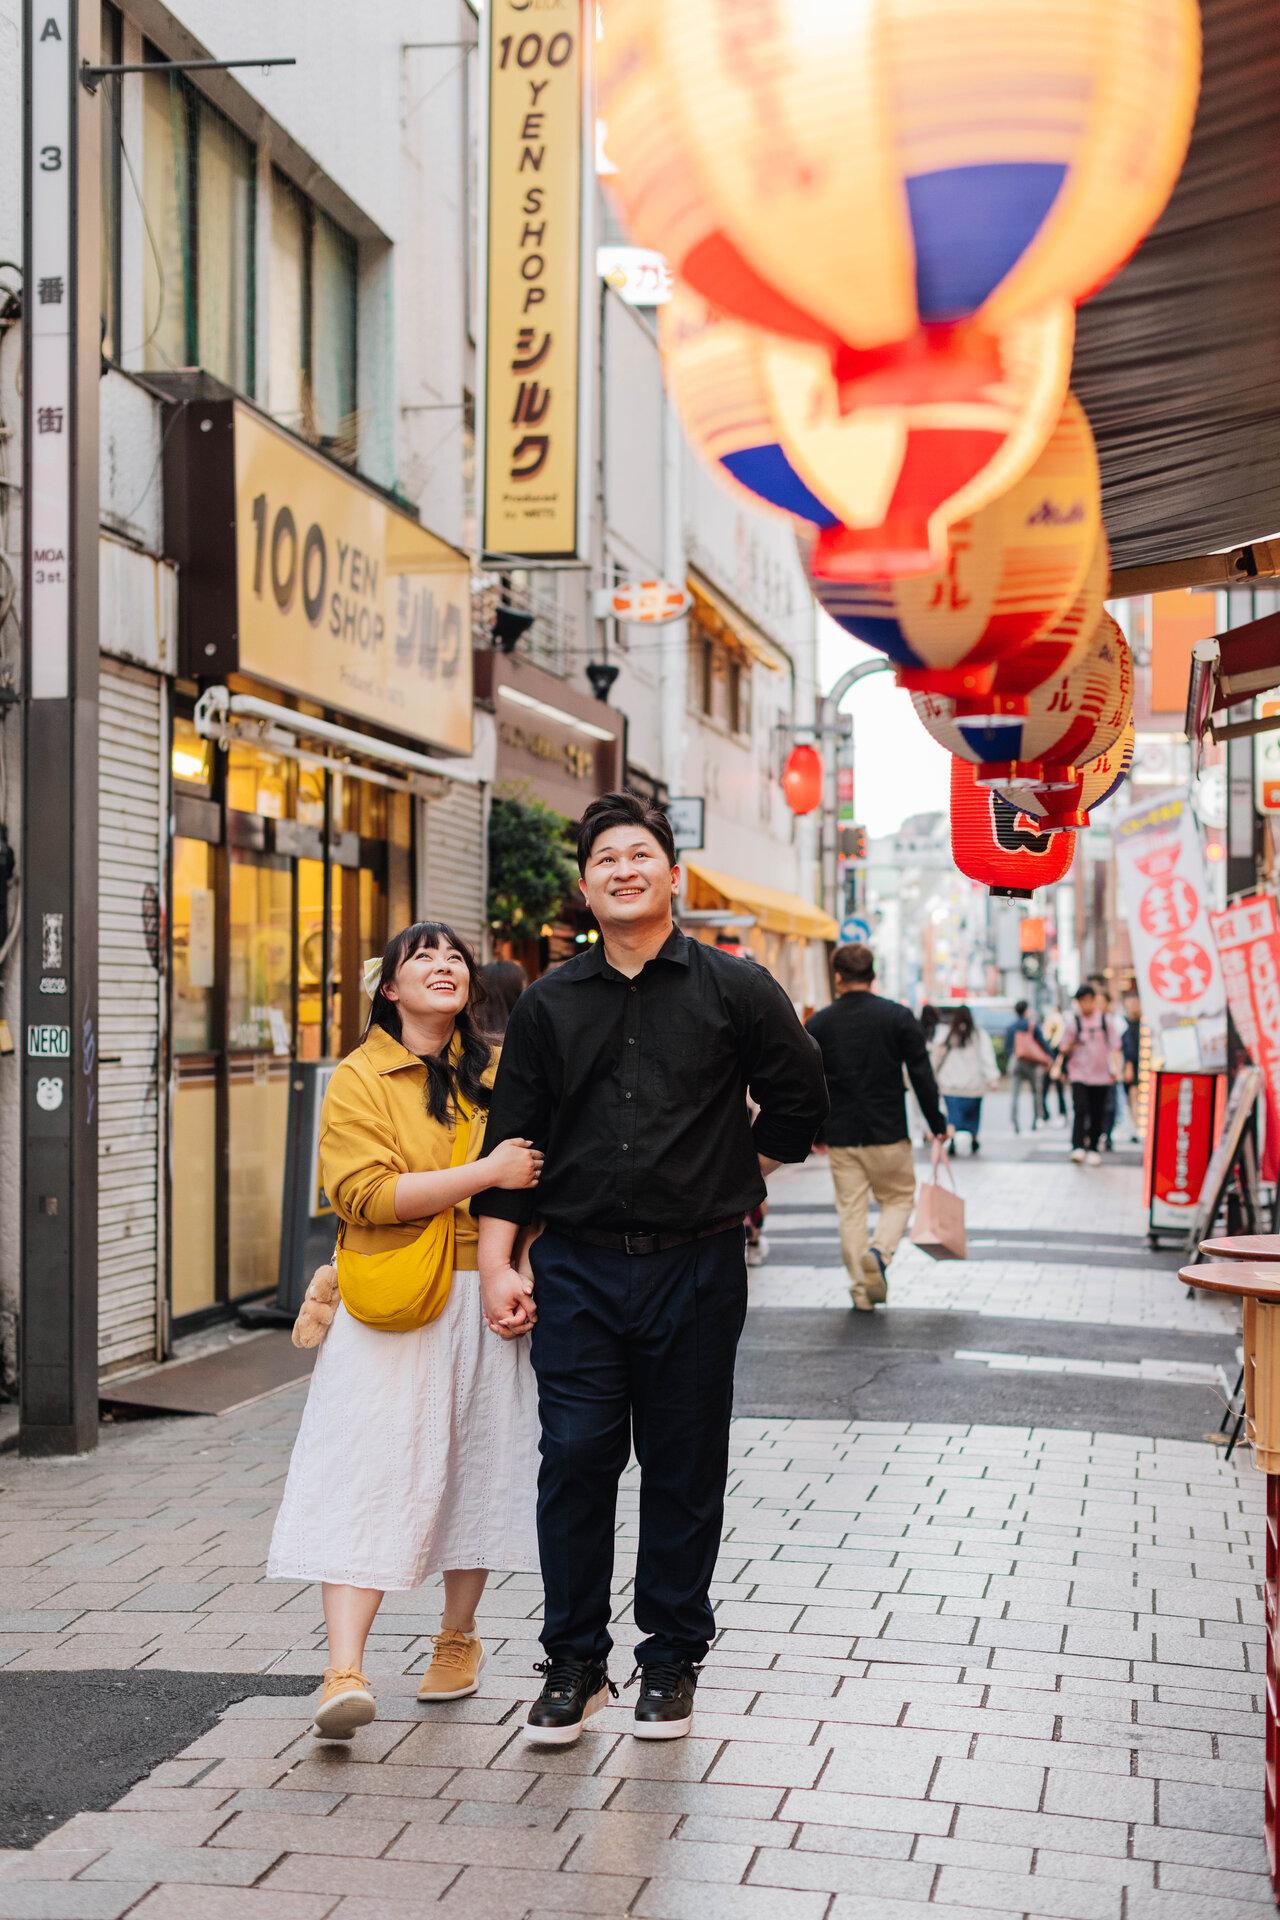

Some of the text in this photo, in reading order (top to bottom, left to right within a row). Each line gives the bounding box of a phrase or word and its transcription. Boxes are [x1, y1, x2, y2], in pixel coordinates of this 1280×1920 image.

[499, 31, 574, 70] 100
[518, 79, 549, 173] YEN
[520, 187, 547, 314] SHOP
[510, 327, 552, 485] シルク
[33, 550, 65, 562] MOA
[252, 493, 379, 627] 100 YEN
[328, 591, 385, 653] SHOP
[30, 1027, 68, 1054] NERO
